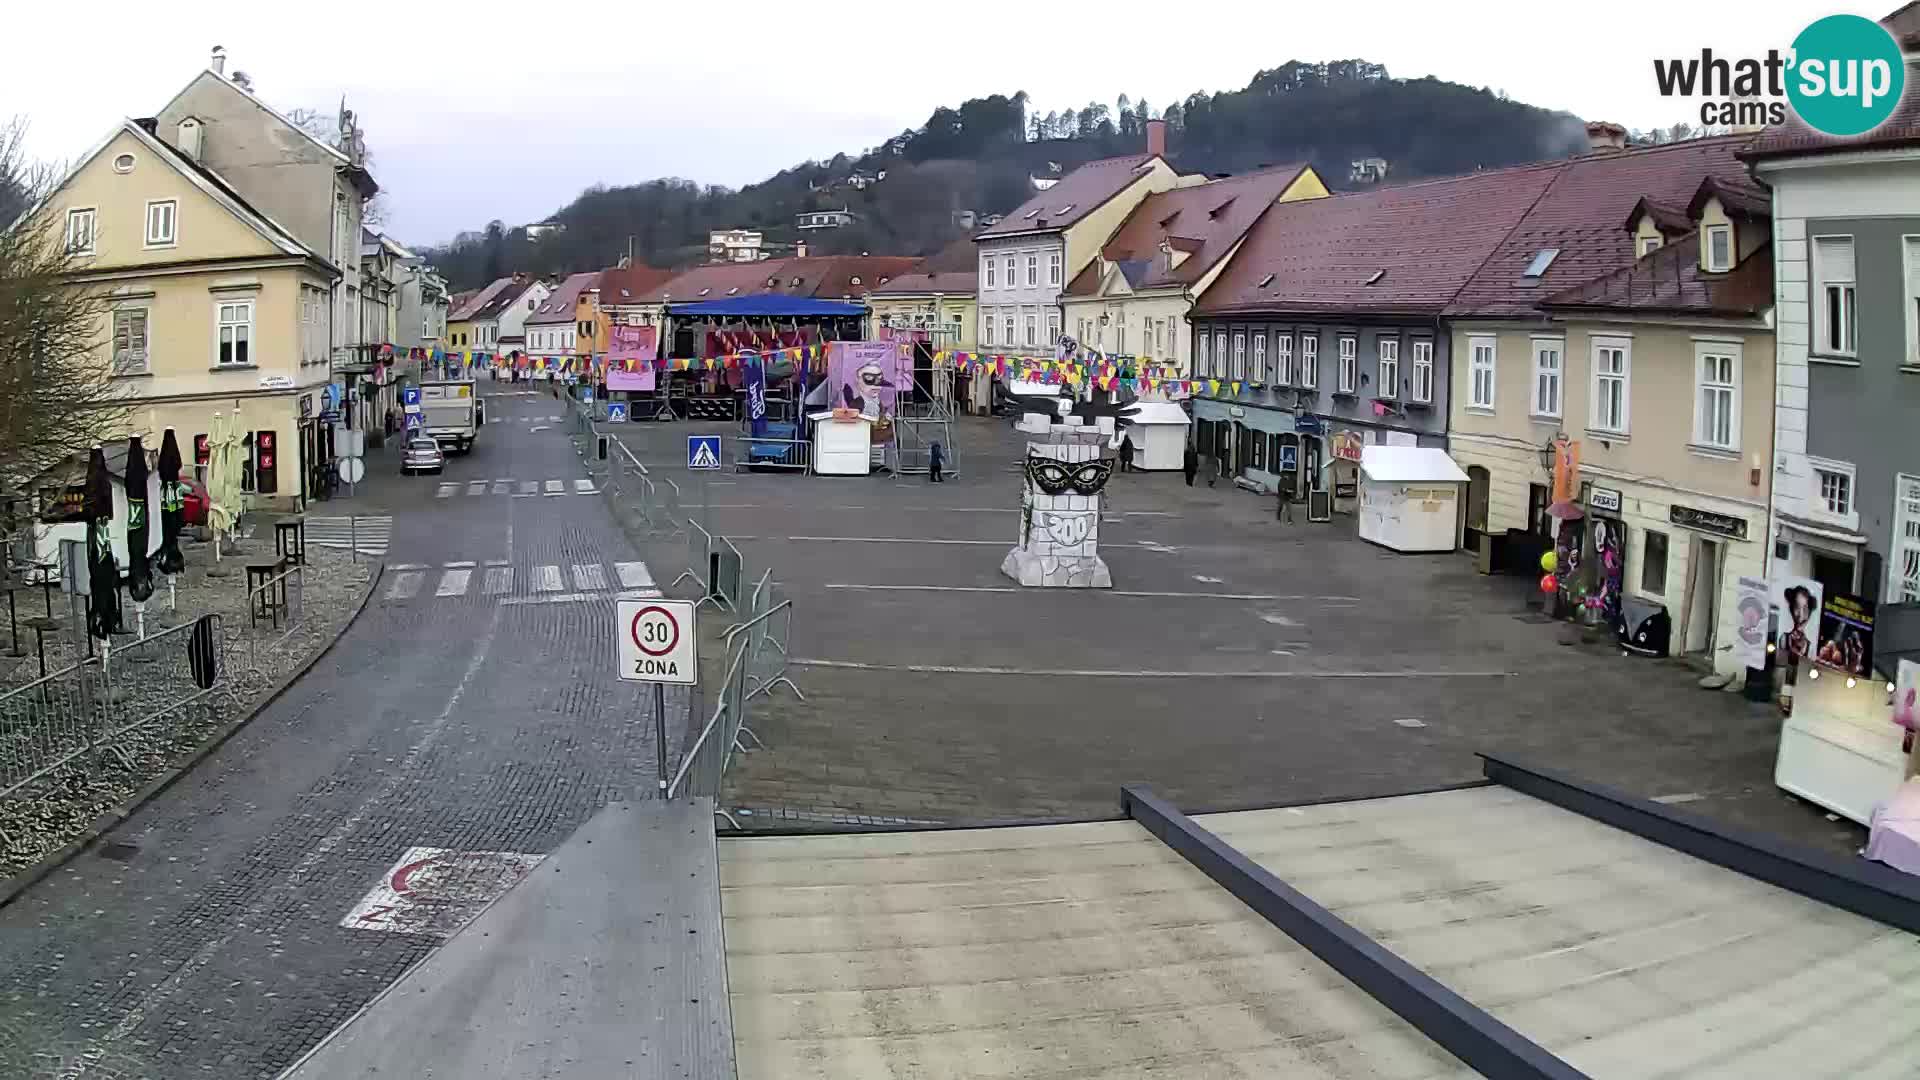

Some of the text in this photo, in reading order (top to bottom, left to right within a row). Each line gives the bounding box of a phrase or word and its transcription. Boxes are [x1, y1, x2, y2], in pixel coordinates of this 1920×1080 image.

[408, 391, 416, 402] P
[1047, 516, 1087, 544] 200
[644, 622, 668, 643] 30
[634, 659, 679, 676] ZONA
